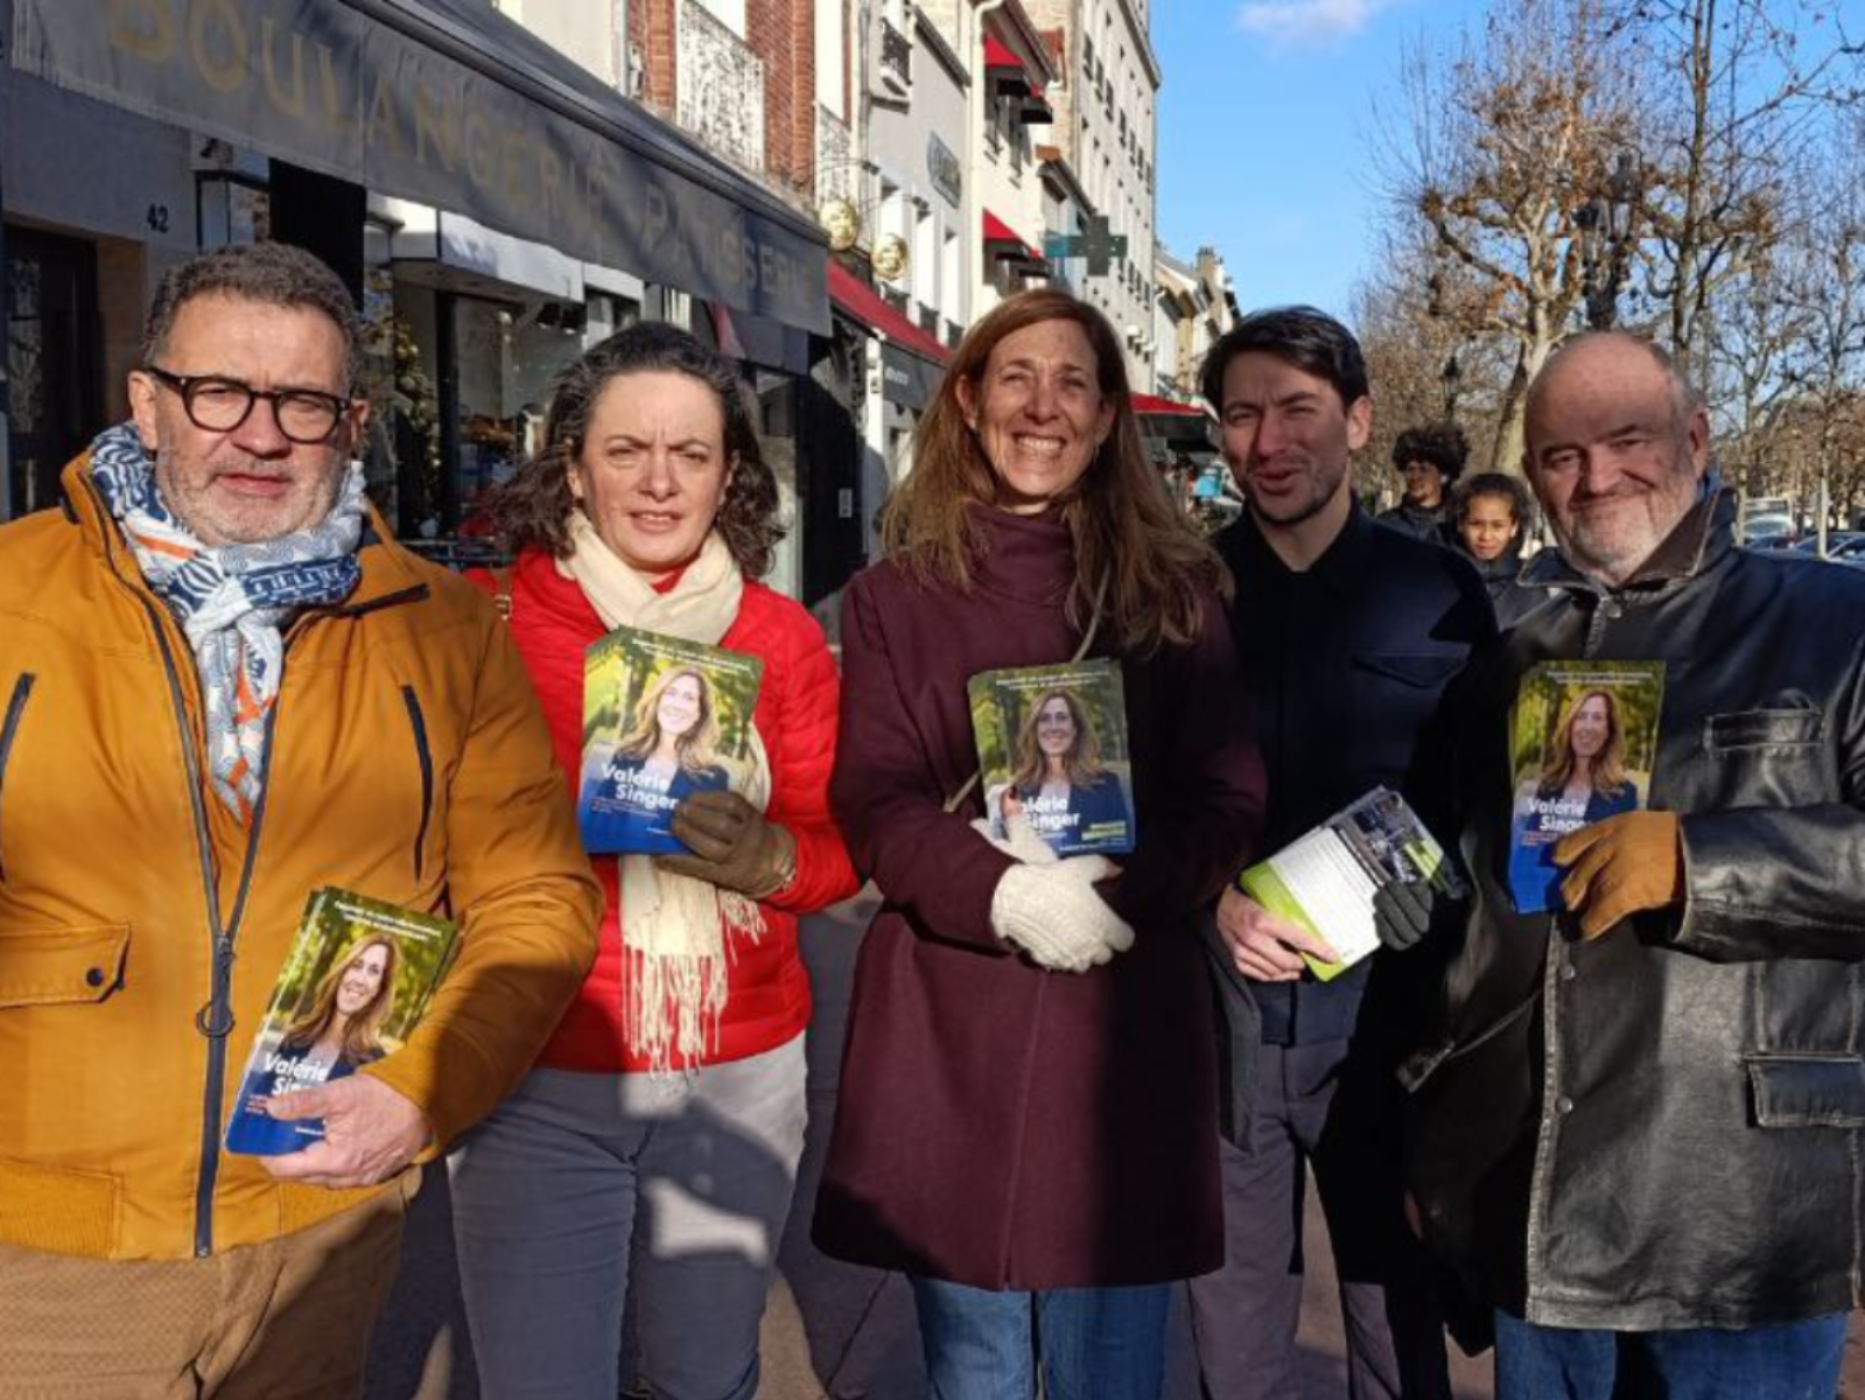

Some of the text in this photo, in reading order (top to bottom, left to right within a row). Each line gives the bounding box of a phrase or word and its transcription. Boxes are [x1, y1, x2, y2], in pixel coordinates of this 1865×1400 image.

[147, 204, 169, 234] 42
[615, 784, 679, 810] Singer
[264, 1053, 328, 1082] Valérie
